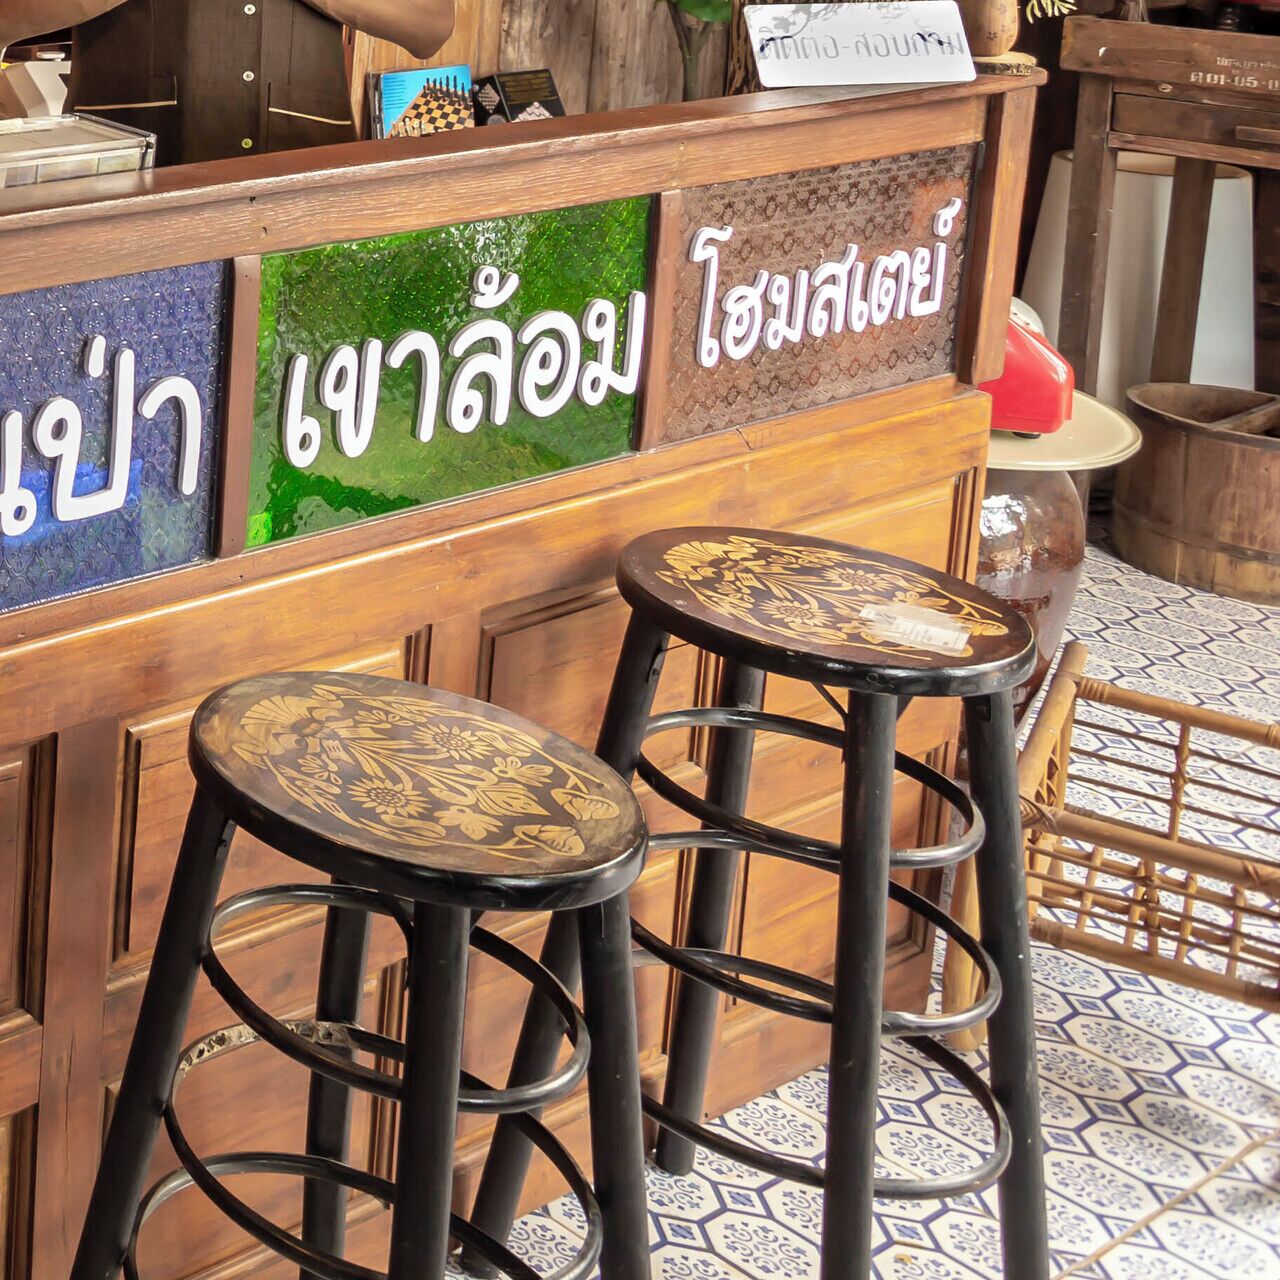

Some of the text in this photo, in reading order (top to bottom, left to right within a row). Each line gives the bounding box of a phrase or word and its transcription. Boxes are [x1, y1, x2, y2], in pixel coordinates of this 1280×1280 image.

[282, 264, 646, 468] เขาล้อม
[688, 196, 964, 370] โฮมสเตย์
